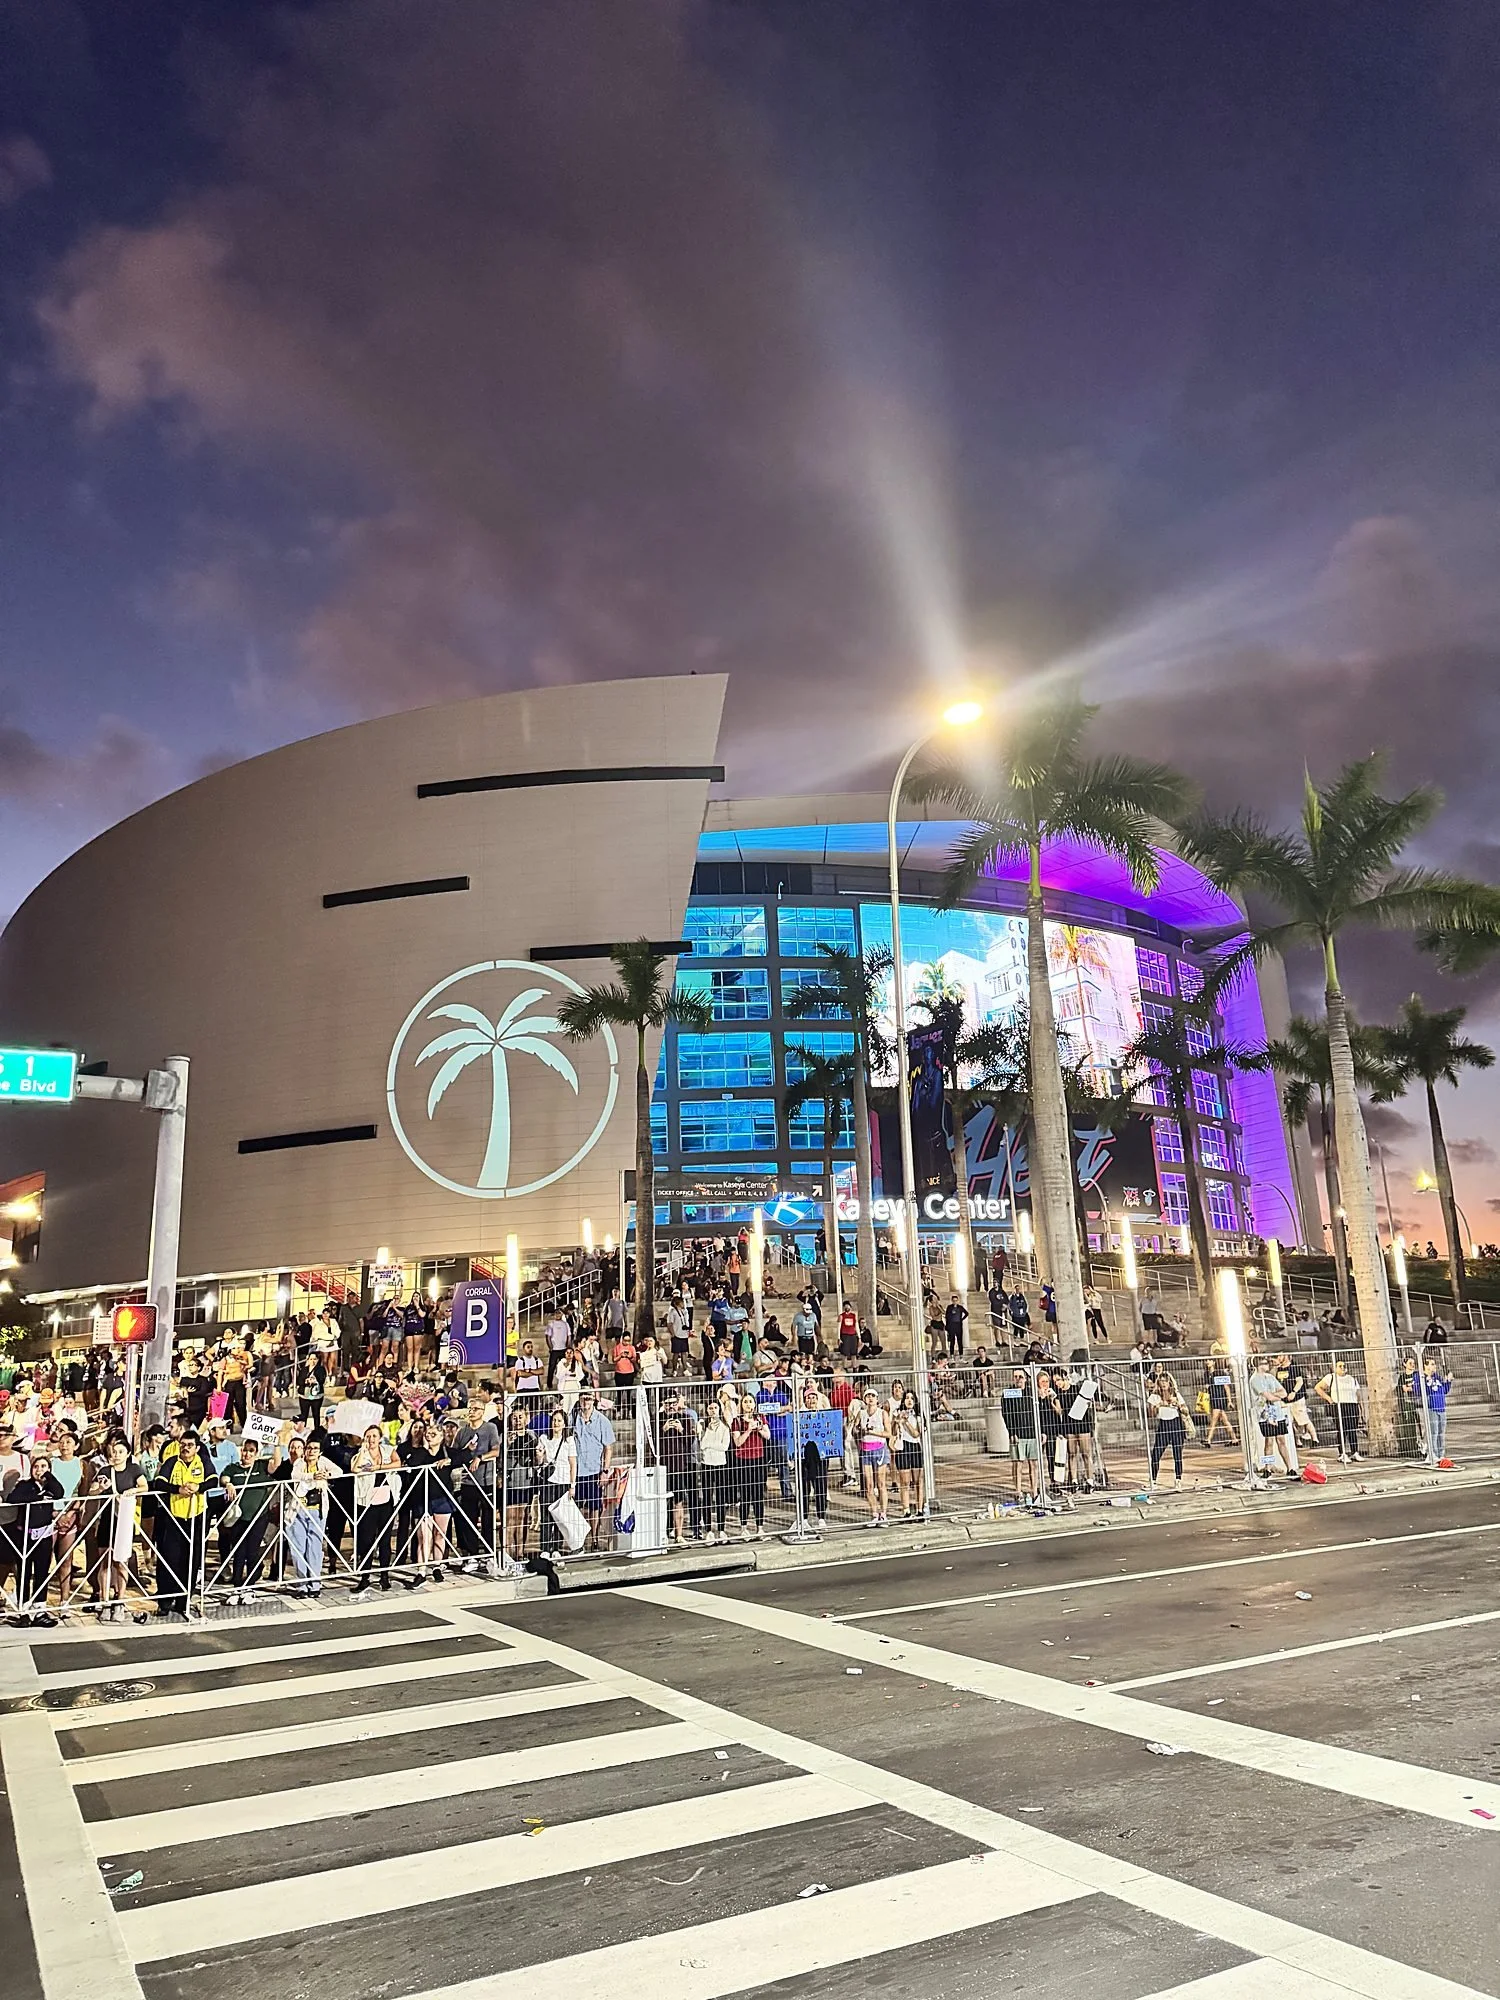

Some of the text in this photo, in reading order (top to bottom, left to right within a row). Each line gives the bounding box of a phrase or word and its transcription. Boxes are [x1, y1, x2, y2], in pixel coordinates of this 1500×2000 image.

[20, 1079, 56, 1093] Blvd
[945, 1103, 1116, 1202] Het
[723, 1181, 745, 1190] Kaseya
[746, 1181, 768, 1189] Center
[924, 1193, 1010, 1220] Center
[672, 1238, 681, 1250] 2
[465, 1287, 492, 1297] CORRAL
[466, 1299, 488, 1337] B
[251, 1415, 263, 1423] GO
[252, 1423, 275, 1433] GABY
[262, 1434, 276, 1443] GO!
